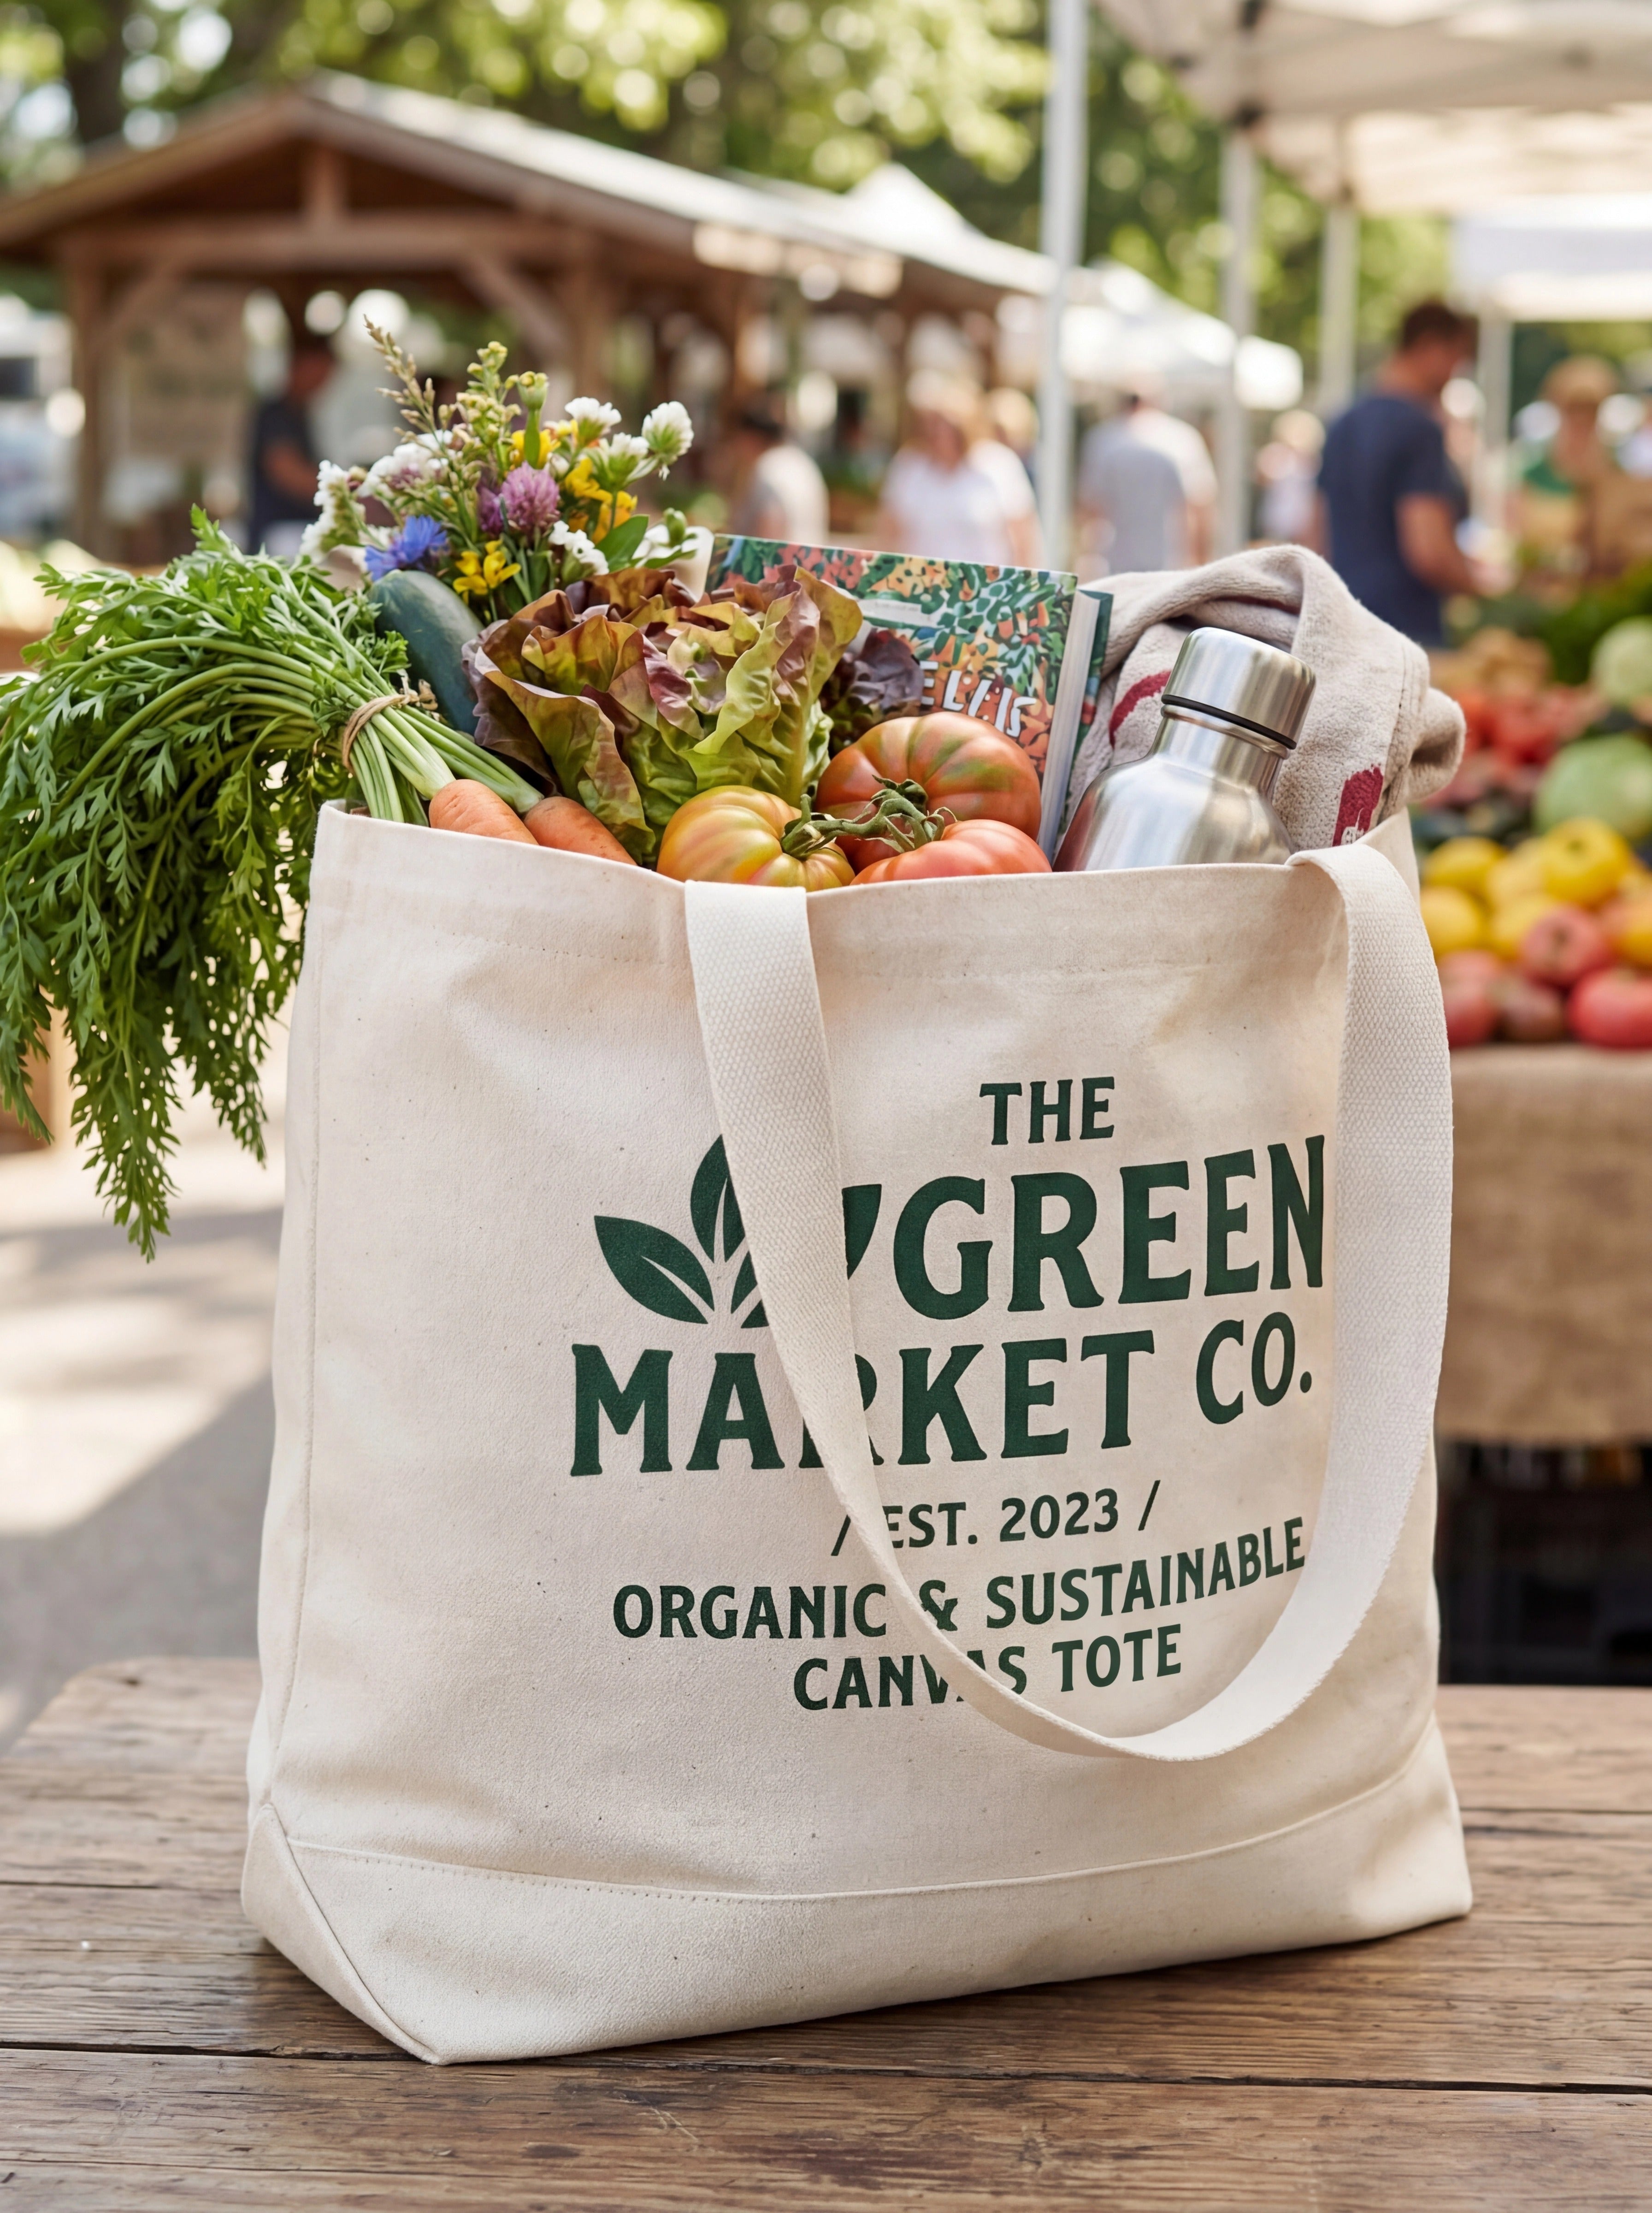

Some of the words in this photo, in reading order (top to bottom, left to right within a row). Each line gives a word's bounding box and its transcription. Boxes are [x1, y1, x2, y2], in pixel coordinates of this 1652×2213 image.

[979, 1076, 1115, 1146] THE
[1196, 1312, 1312, 1425] CO.
[882, 1502, 978, 1549] EST.
[1000, 1488, 1119, 1542] 2023
[613, 1583, 886, 1639] ORGANIC
[919, 1580, 958, 1632] &
[986, 1516, 1305, 1629] SUSTAINABLE
[1051, 1623, 1181, 1692] TOTE
